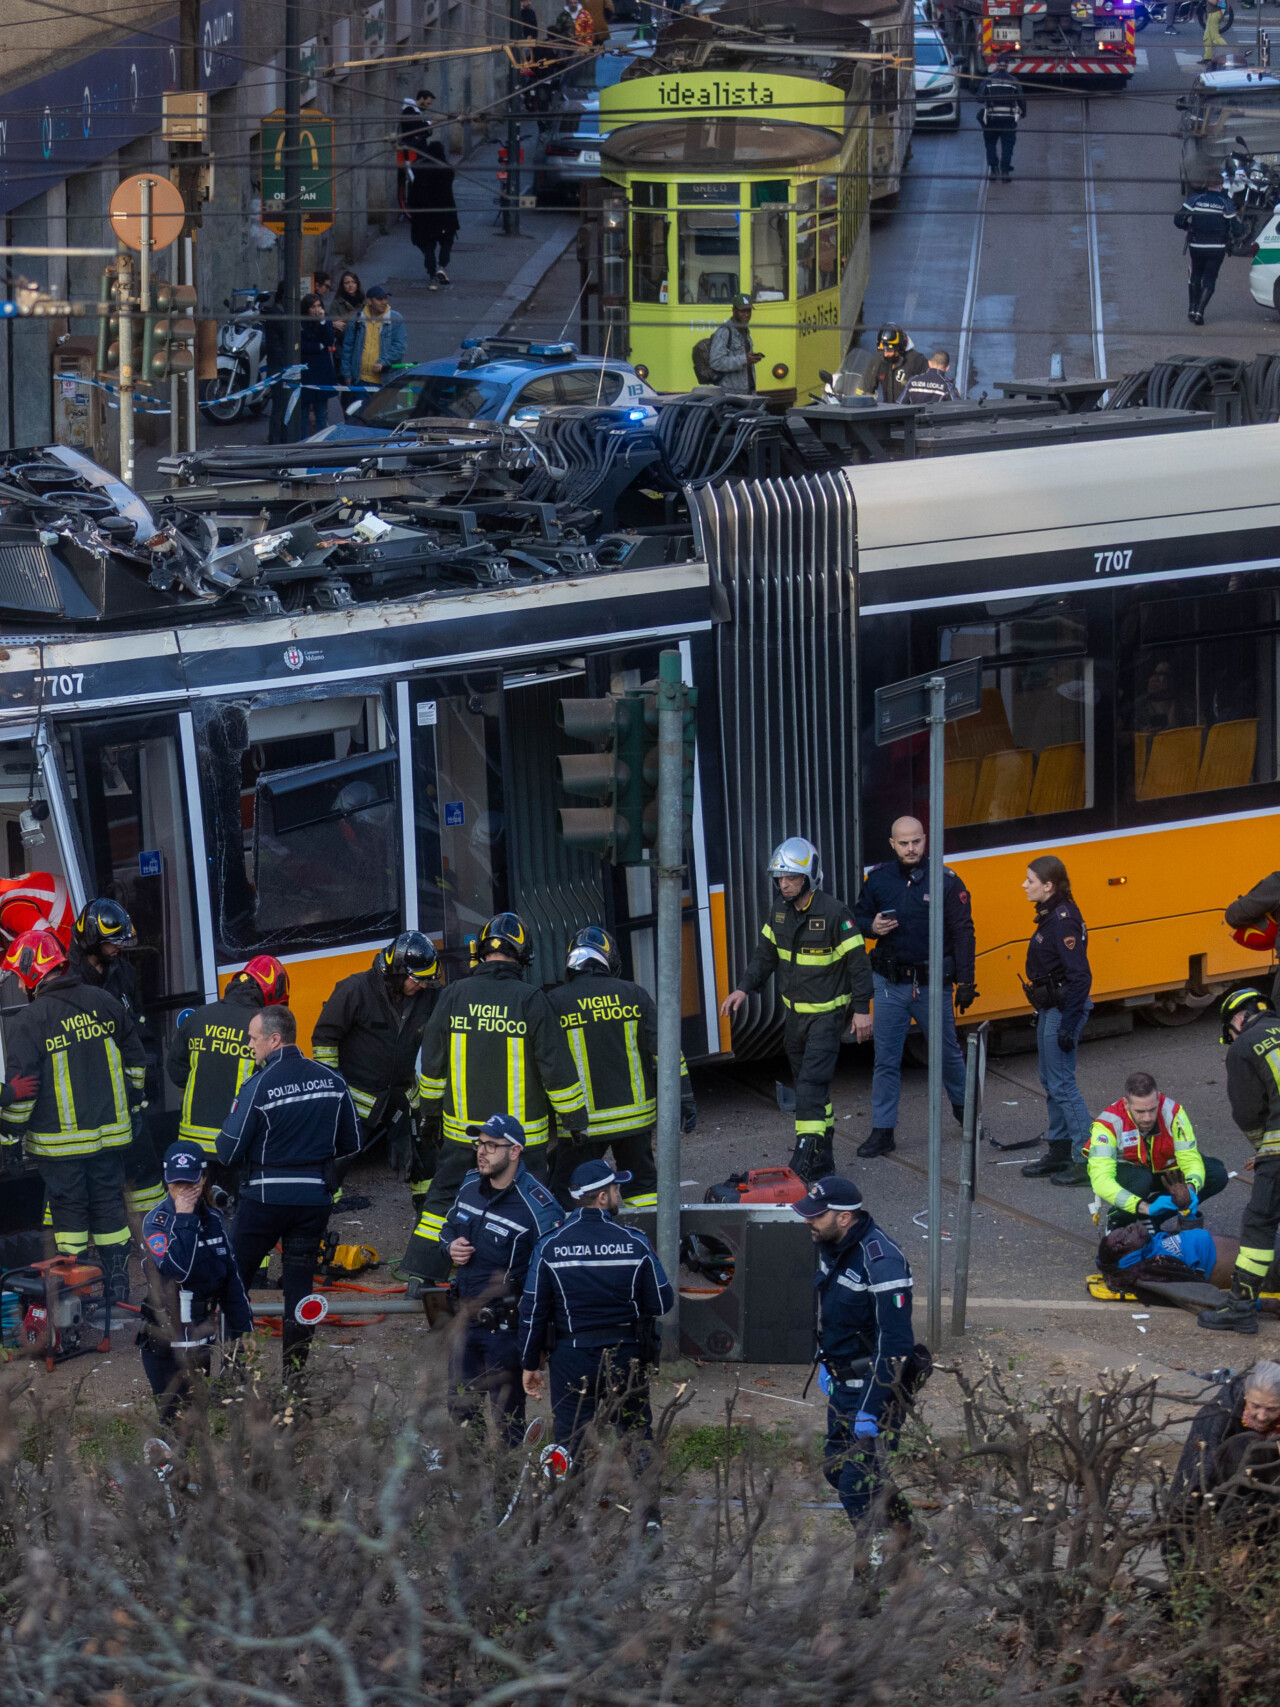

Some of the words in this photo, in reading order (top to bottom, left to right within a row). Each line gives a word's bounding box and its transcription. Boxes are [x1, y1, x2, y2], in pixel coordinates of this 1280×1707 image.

[658, 81, 773, 105] idealista
[798, 301, 838, 338] idealista
[627, 384, 644, 397] 113
[1093, 549, 1133, 573] 7707
[469, 1003, 508, 1019] VIGILI
[577, 994, 621, 1011] VIGILI
[61, 1010, 98, 1032] VIGILI
[477, 1018, 527, 1035] FUOCO
[560, 1012, 588, 1028] DEL
[45, 1034, 72, 1052] DEL
[76, 1020, 115, 1043] FUOCO
[205, 1024, 244, 1042] VIGILI
[189, 1037, 206, 1051] DEL
[267, 1083, 301, 1099] POLIZIA
[302, 1078, 335, 1092] LOCALE
[554, 1244, 592, 1258] POLIZIA
[594, 1243, 634, 1255] LOCALE
